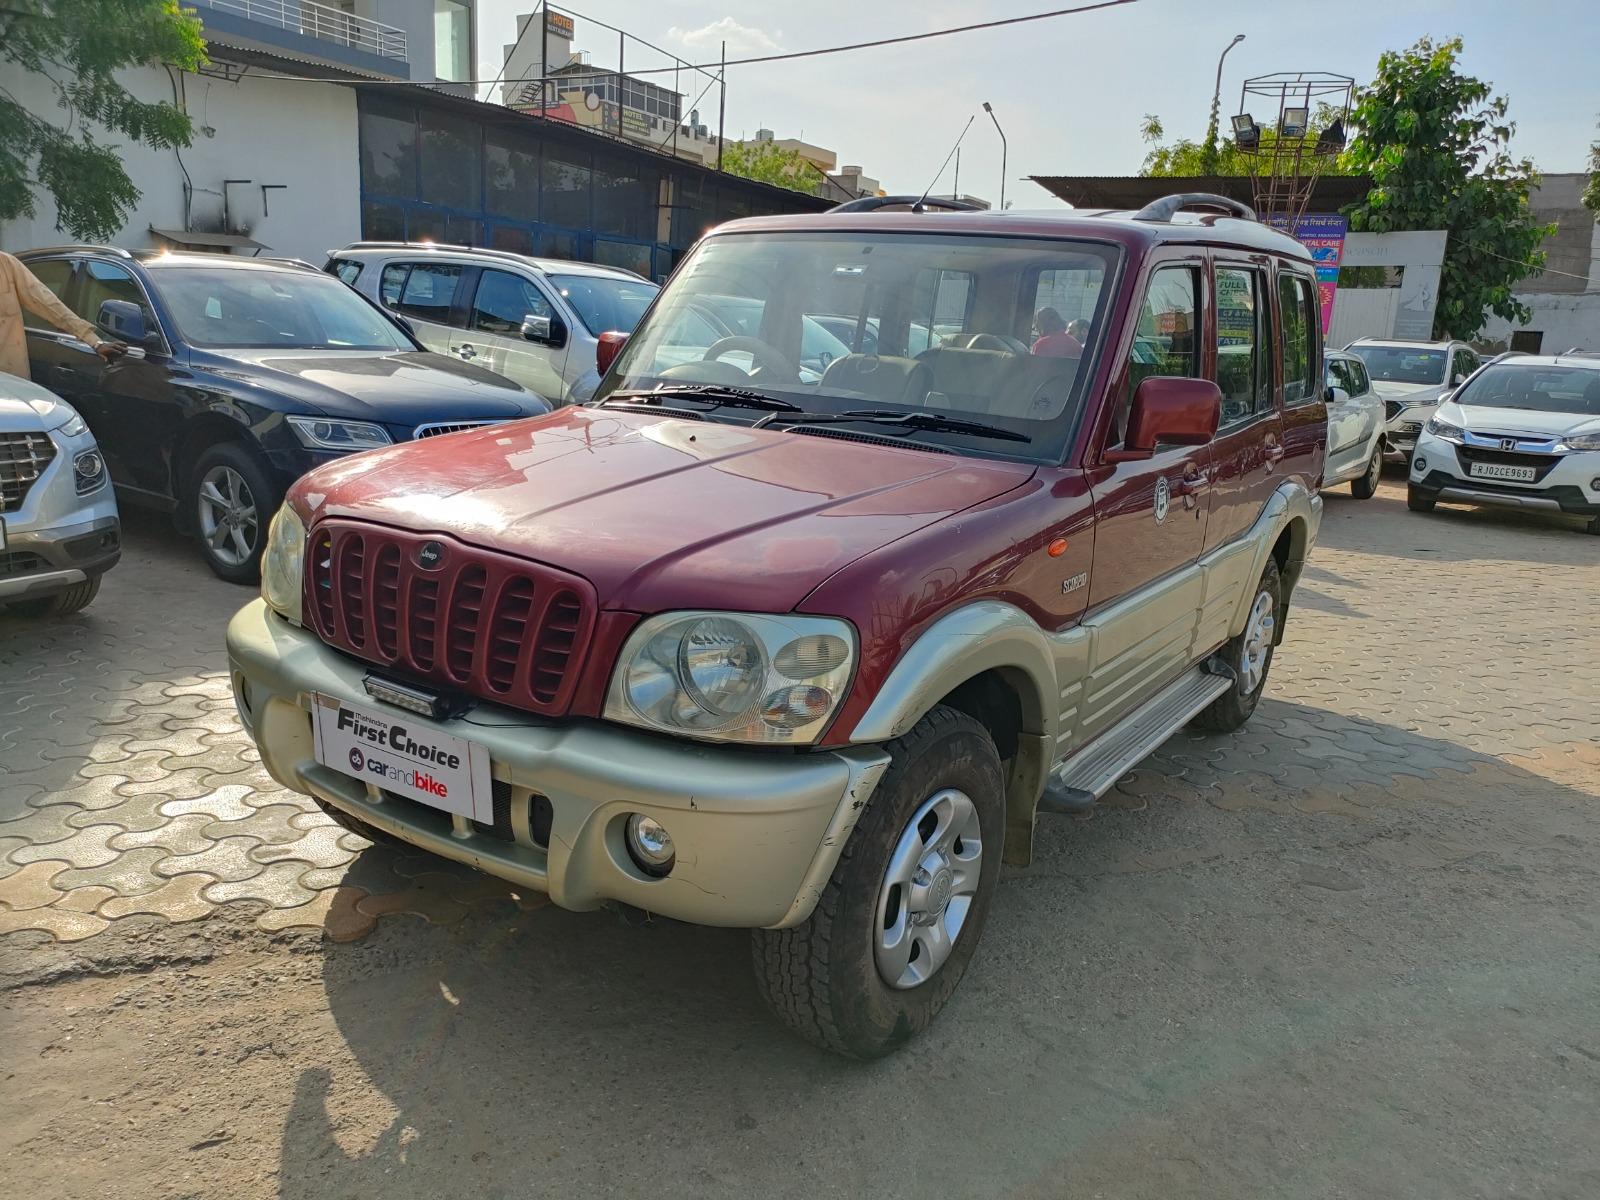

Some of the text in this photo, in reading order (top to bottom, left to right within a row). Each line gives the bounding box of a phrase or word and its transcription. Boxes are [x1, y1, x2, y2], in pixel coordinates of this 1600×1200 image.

[552, 14, 573, 30] HOTEL
[623, 108, 643, 120] HOTEL
[1477, 465, 1533, 479] RJ02CE9693
[421, 549, 438, 561] Jeep
[337, 707, 460, 770] First Choice
[367, 758, 448, 798] carandbike
